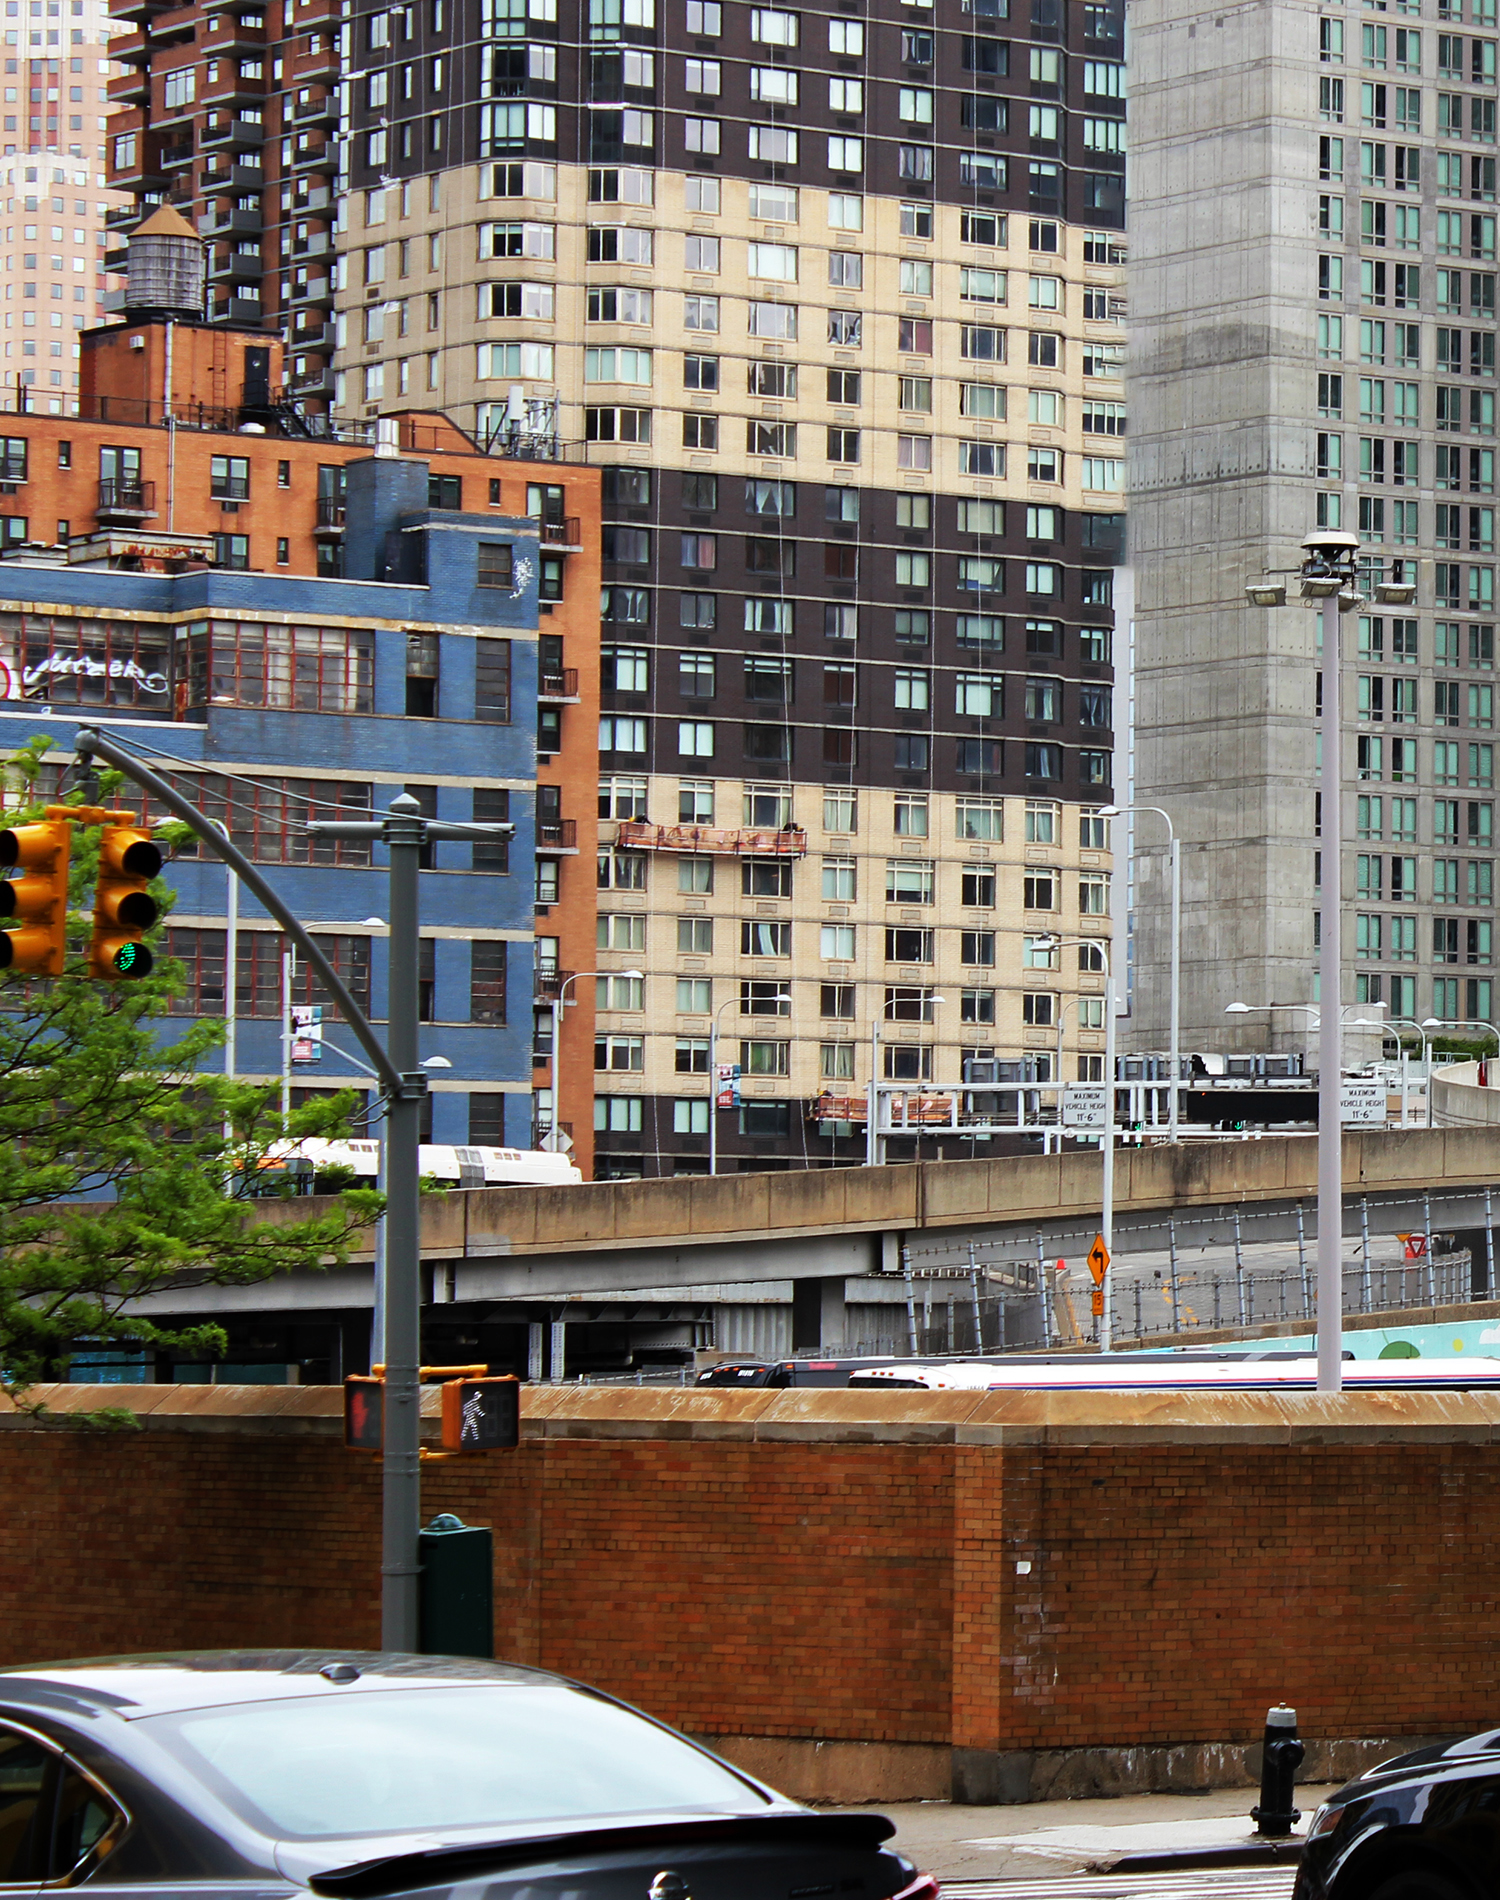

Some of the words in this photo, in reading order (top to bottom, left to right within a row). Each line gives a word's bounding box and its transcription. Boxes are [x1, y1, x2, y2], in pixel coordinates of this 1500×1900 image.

[1073, 1092, 1100, 1100] MAXIMUM
[1065, 1102, 1087, 1110] VEHICLE
[1089, 1102, 1106, 1110] HEIGH
[1340, 1099, 1363, 1107] VEHICLE
[1365, 1099, 1385, 1107] HEIGHT
[1093, 1293, 1102, 1306] 15
